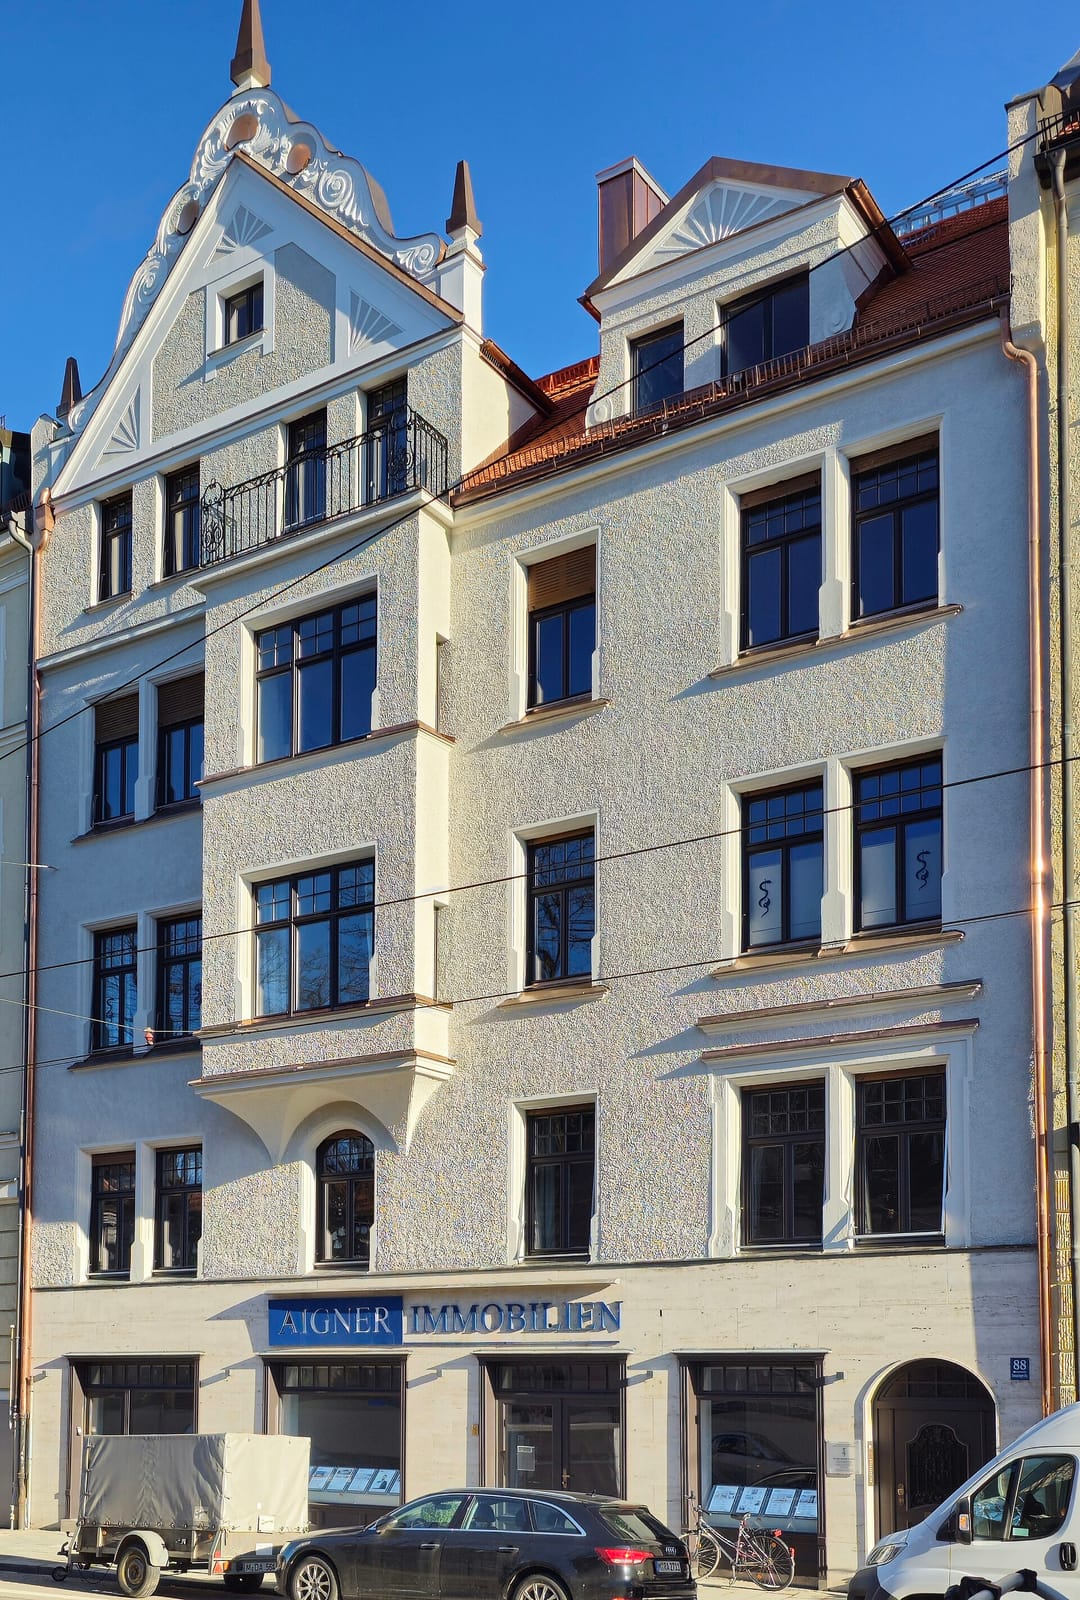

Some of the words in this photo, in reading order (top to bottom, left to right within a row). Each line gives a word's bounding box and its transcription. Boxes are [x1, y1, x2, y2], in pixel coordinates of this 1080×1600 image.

[278, 1306, 393, 1335] AIGNER
[411, 1301, 623, 1333] IMMOBILIEN
[1013, 1359, 1027, 1370] 88
